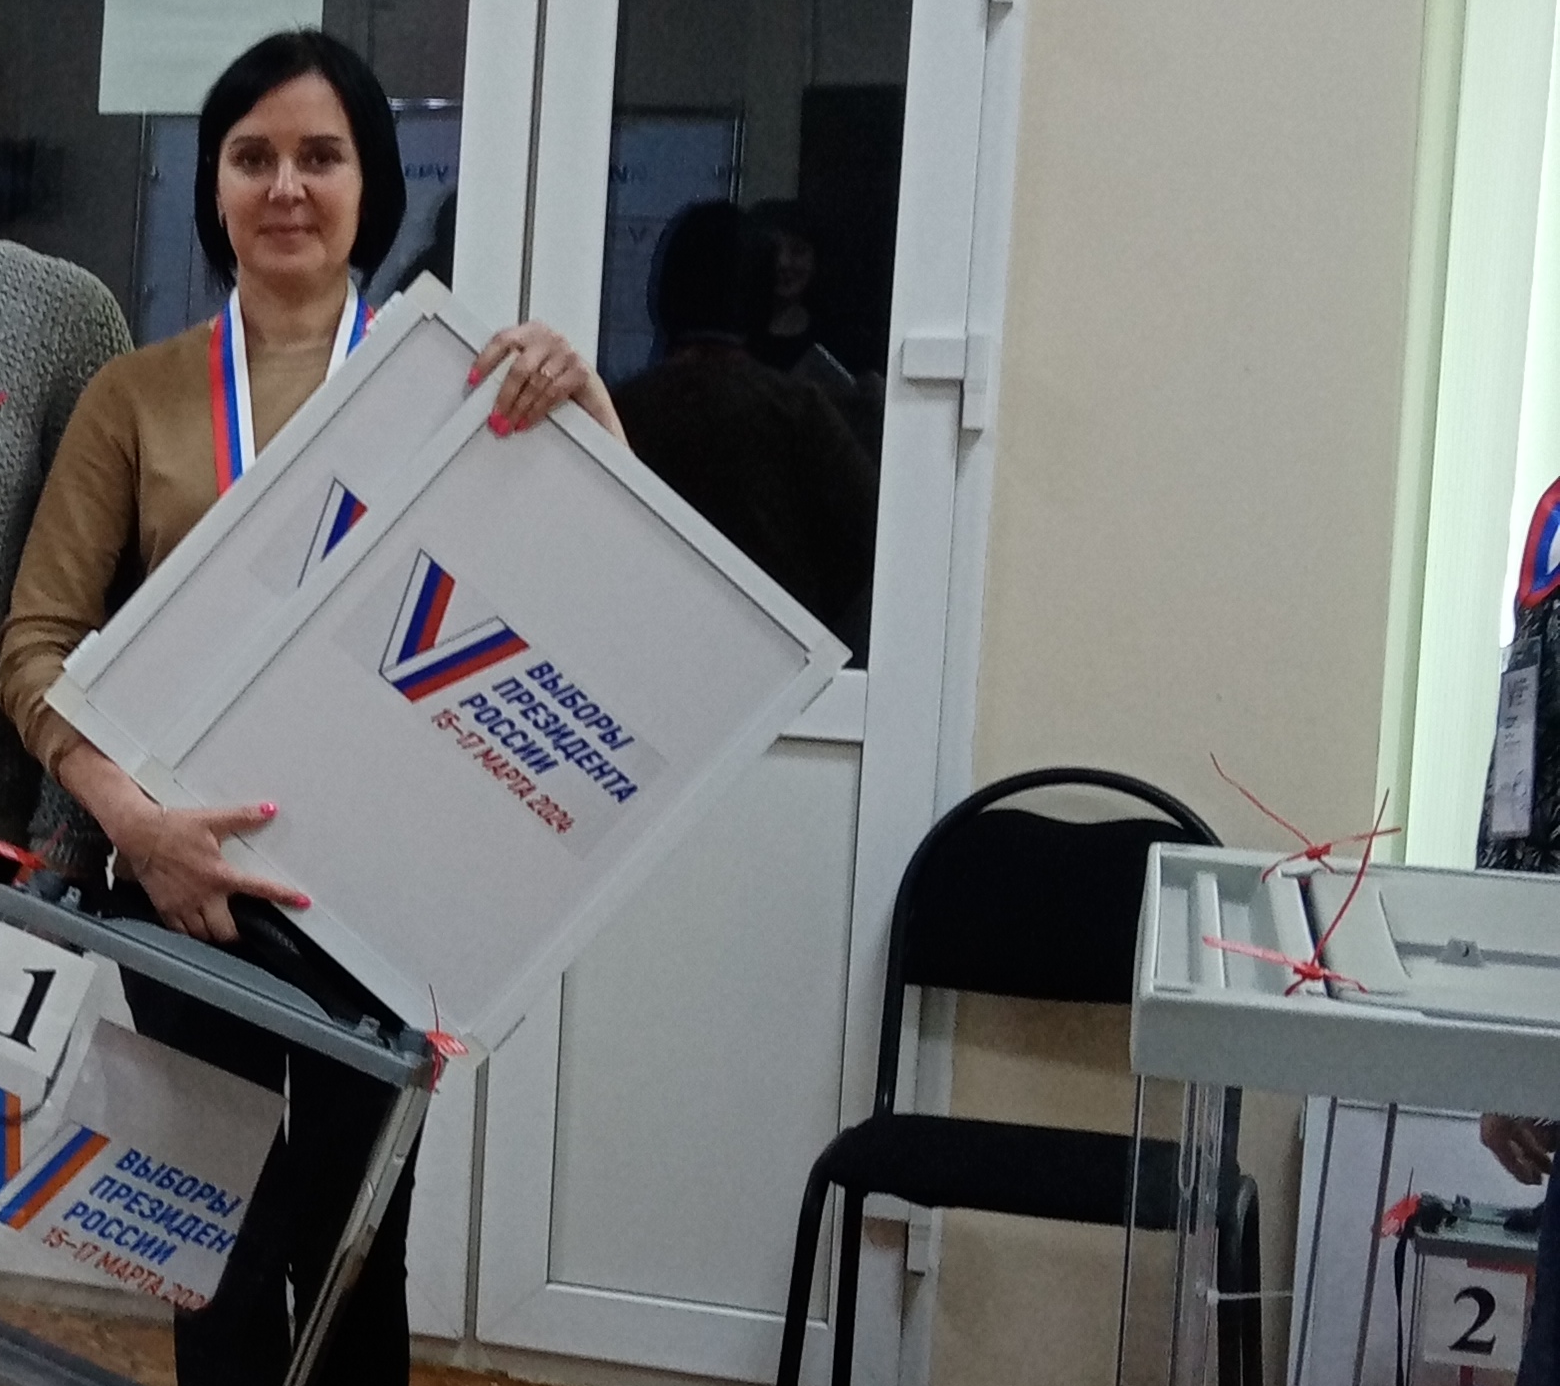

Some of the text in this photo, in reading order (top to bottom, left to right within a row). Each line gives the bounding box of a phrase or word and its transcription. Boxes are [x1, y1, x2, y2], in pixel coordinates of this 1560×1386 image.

[458, 692, 559, 776] РОССИИ
[492, 676, 639, 804] ПРЕЗИДЕНТА
[525, 660, 634, 752] ВЫБОРЫ
[473, 747, 537, 801] МАРТА
[526, 793, 576, 835] 2024
[89, 1175, 238, 1254] ПРЕЗИДЕН
[115, 1147, 241, 1216] ВЫБОРЫ
[63, 1201, 177, 1266] РОССИИ
[94, 1252, 165, 1297] МАРТА
[1447, 1286, 1497, 1356] 2
